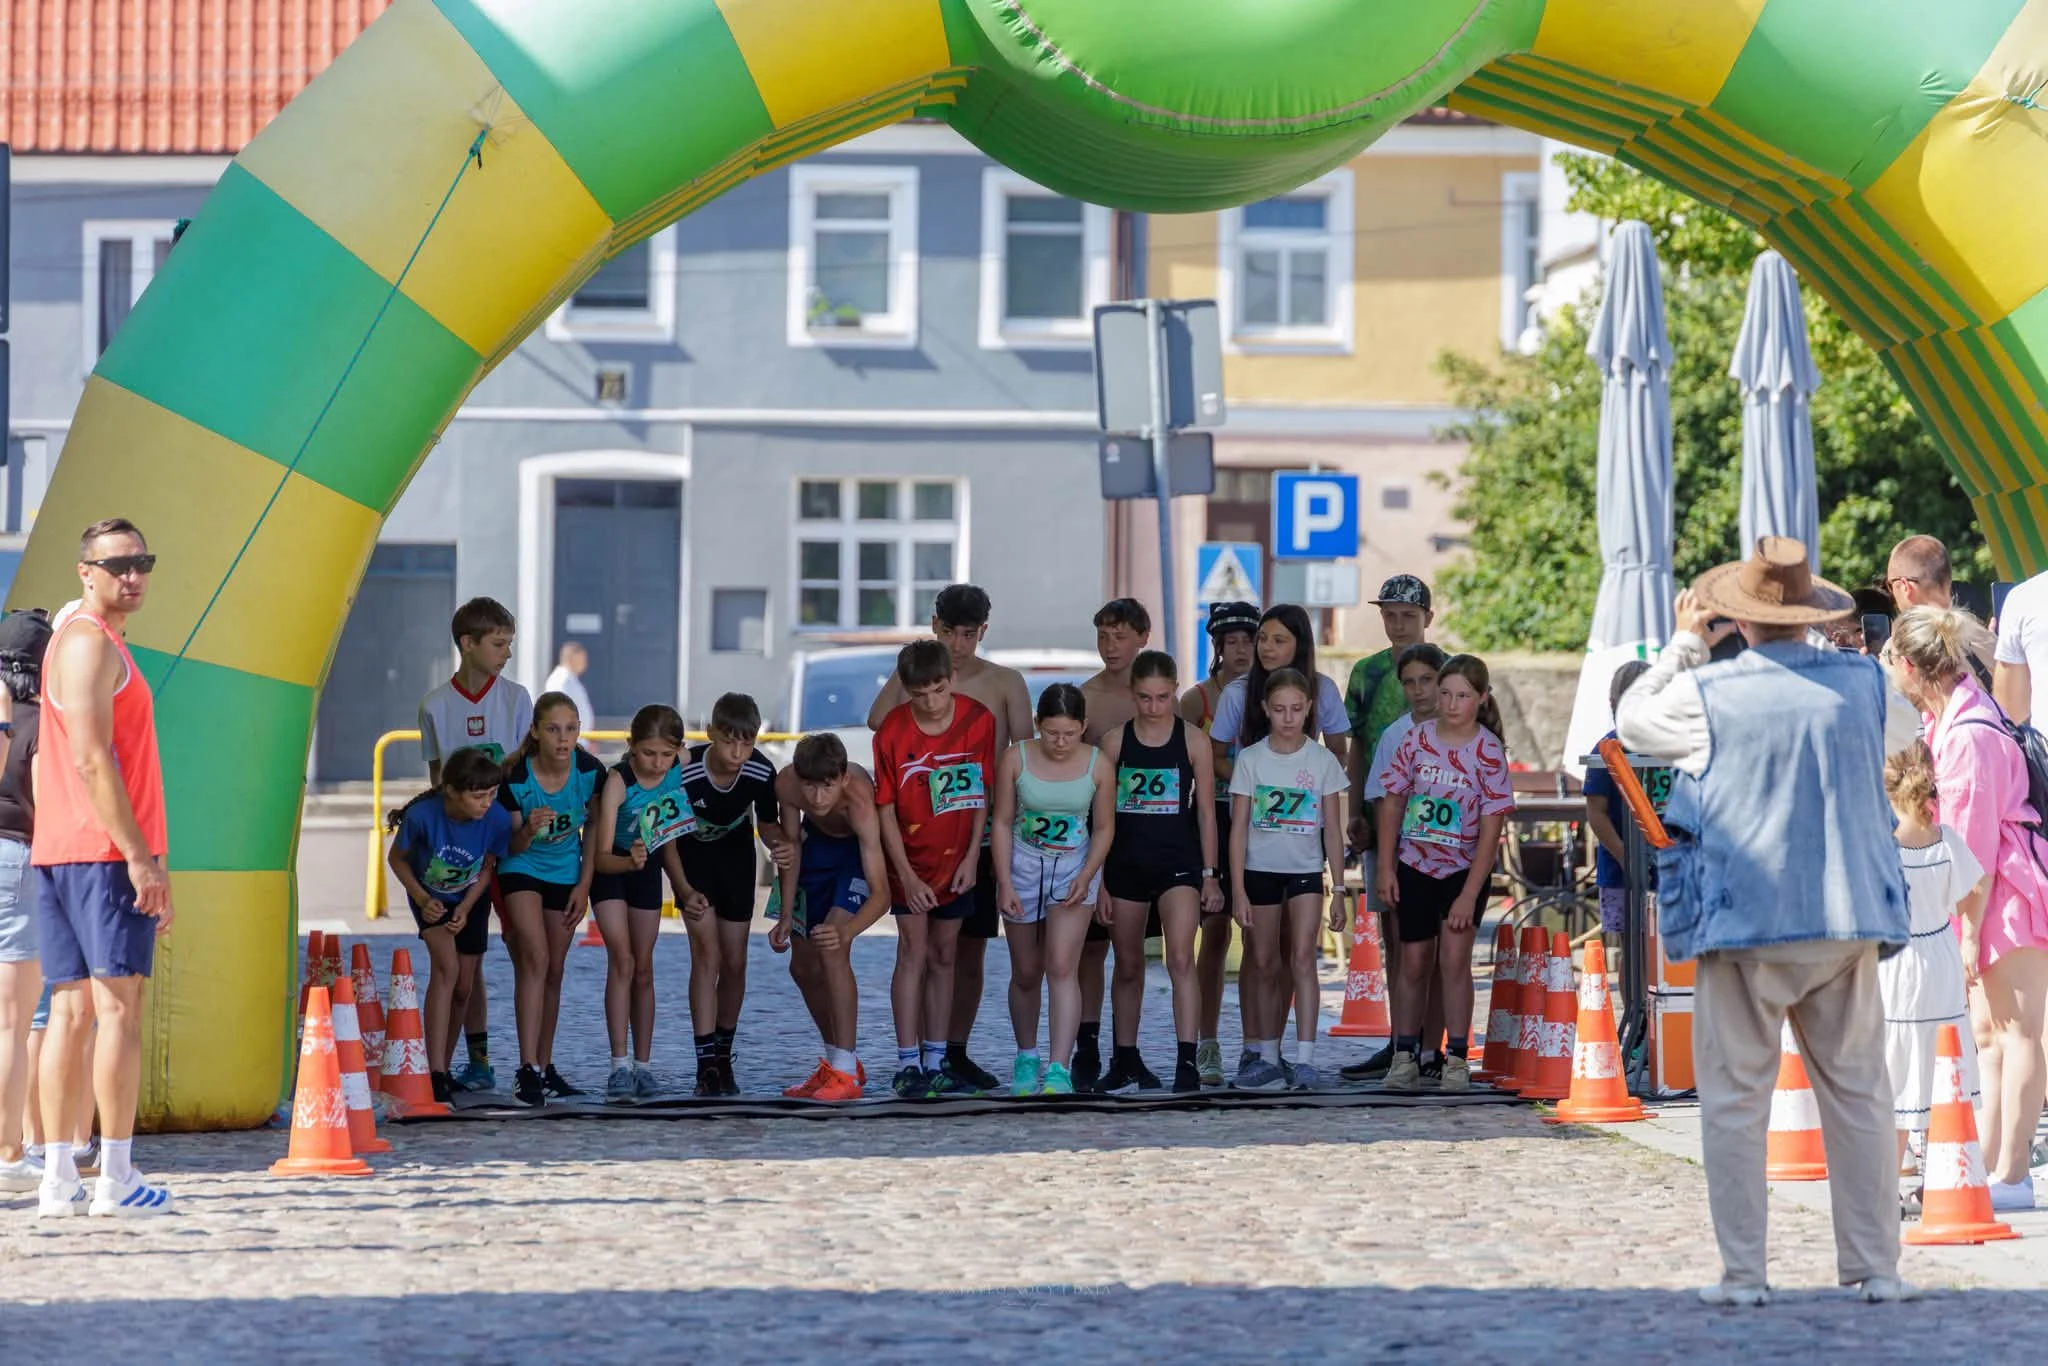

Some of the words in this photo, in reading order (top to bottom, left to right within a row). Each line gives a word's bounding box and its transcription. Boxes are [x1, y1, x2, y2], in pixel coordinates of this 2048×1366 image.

[1293, 481, 1345, 551] P
[938, 768, 972, 795] 25
[1130, 772, 1166, 796] 26
[1419, 765, 1468, 788] CHILL
[646, 798, 680, 829] 23
[1267, 790, 1307, 815] 27
[1418, 799, 1453, 827] 30
[548, 813, 571, 835] 18
[1034, 816, 1069, 842] 22
